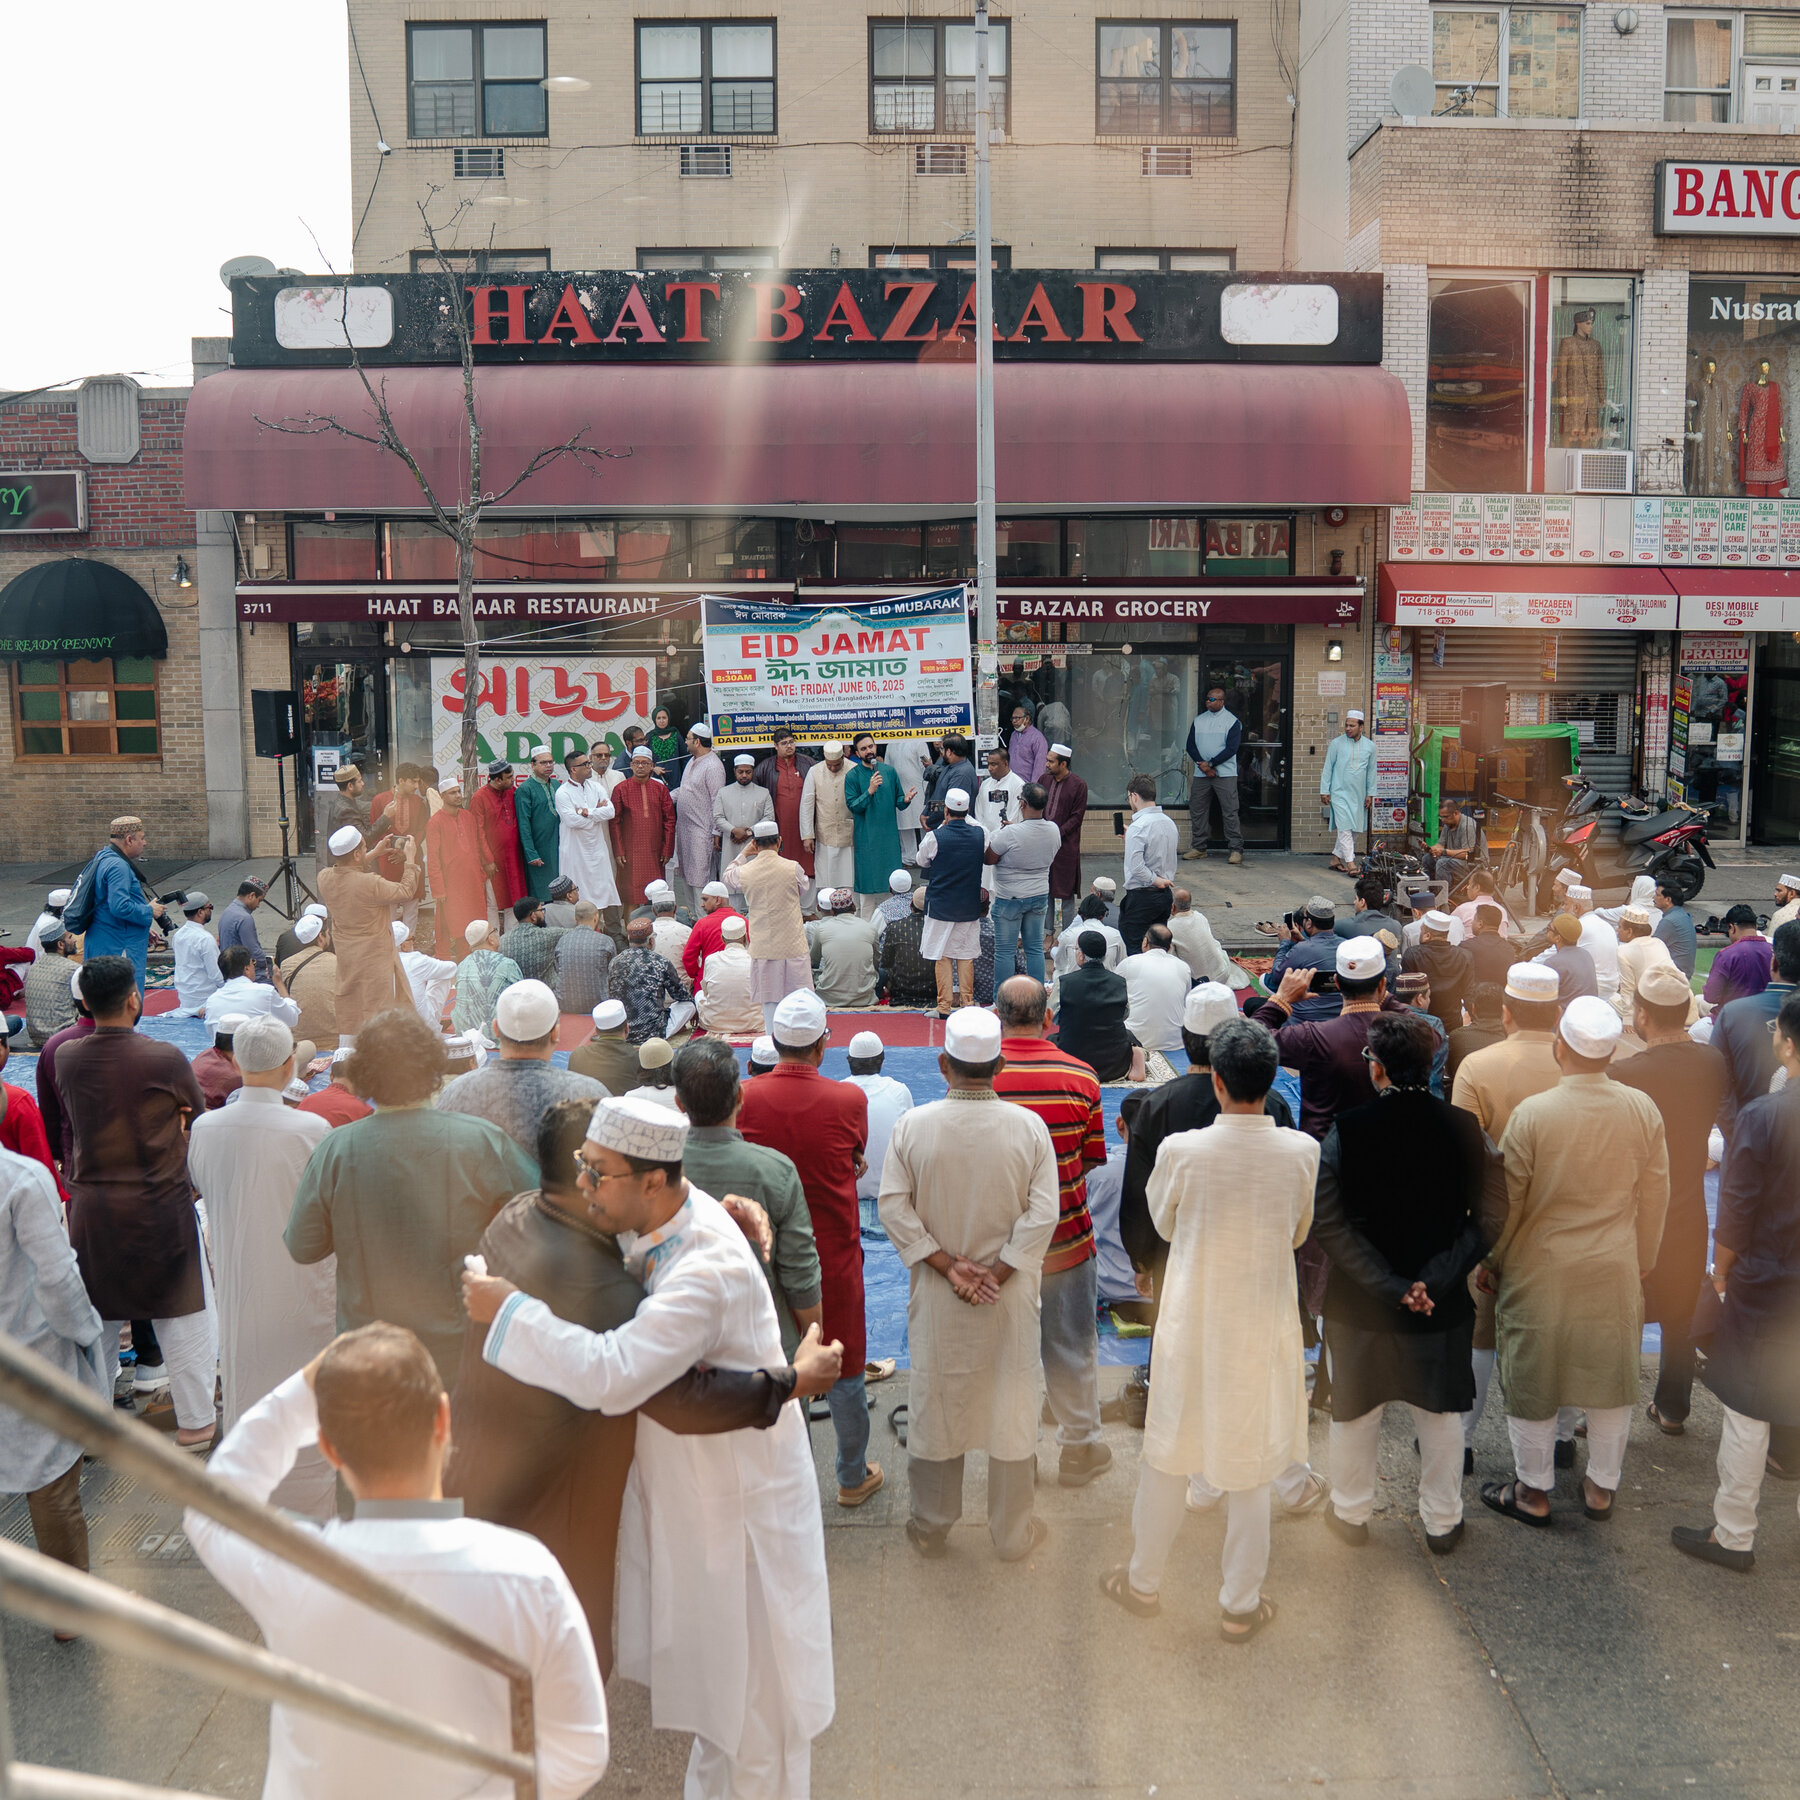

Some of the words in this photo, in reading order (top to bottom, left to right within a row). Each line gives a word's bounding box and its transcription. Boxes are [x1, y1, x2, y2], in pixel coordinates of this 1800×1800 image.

[465, 281, 720, 344] HAAT
[748, 281, 1144, 342] BAZAAR
[1709, 296, 1800, 320] Nusrat
[1724, 513, 1747, 521] HOME
[1725, 523, 1746, 531] CARE
[368, 599, 421, 615] HAAT
[433, 599, 516, 615] BAAAR
[528, 598, 660, 614] RESTAURANT
[870, 606, 891, 615] EID
[895, 597, 960, 613] MUBARAK
[1447, 597, 1466, 605] Money
[1528, 599, 1572, 608] MEHZABEEN
[1639, 600, 1666, 608] TAILORING
[1706, 602, 1724, 610] DESI
[1728, 602, 1759, 610] MOBILE
[244, 603, 271, 614] 3711
[1020, 601, 1103, 616] BAZAAR
[1115, 601, 1211, 616] GROCERY
[752, 612, 786, 620] মোবারক
[15, 638, 63, 652] READY
[62, 636, 115, 649] PENNY
[741, 635, 799, 659] EID
[811, 628, 930, 656] JAMAT
[1684, 649, 1746, 659] PRABHU
[765, 658, 810, 681] ঈদ
[816, 658, 908, 679] জামাত
[771, 685, 798, 697] DATE:
[801, 683, 835, 696] FRIDAY,
[838, 681, 863, 694] JUNE
[866, 681, 880, 694] 06,
[883, 680, 905, 691] 2025
[735, 715, 755, 723] Jackson
[756, 714, 774, 723] Heights
[776, 713, 804, 722] Bangladeshi
[829, 711, 856, 720] Association
[858, 710, 868, 718] NYC
[869, 710, 876, 718] US
[916, 727, 966, 736] HEIGHTS
